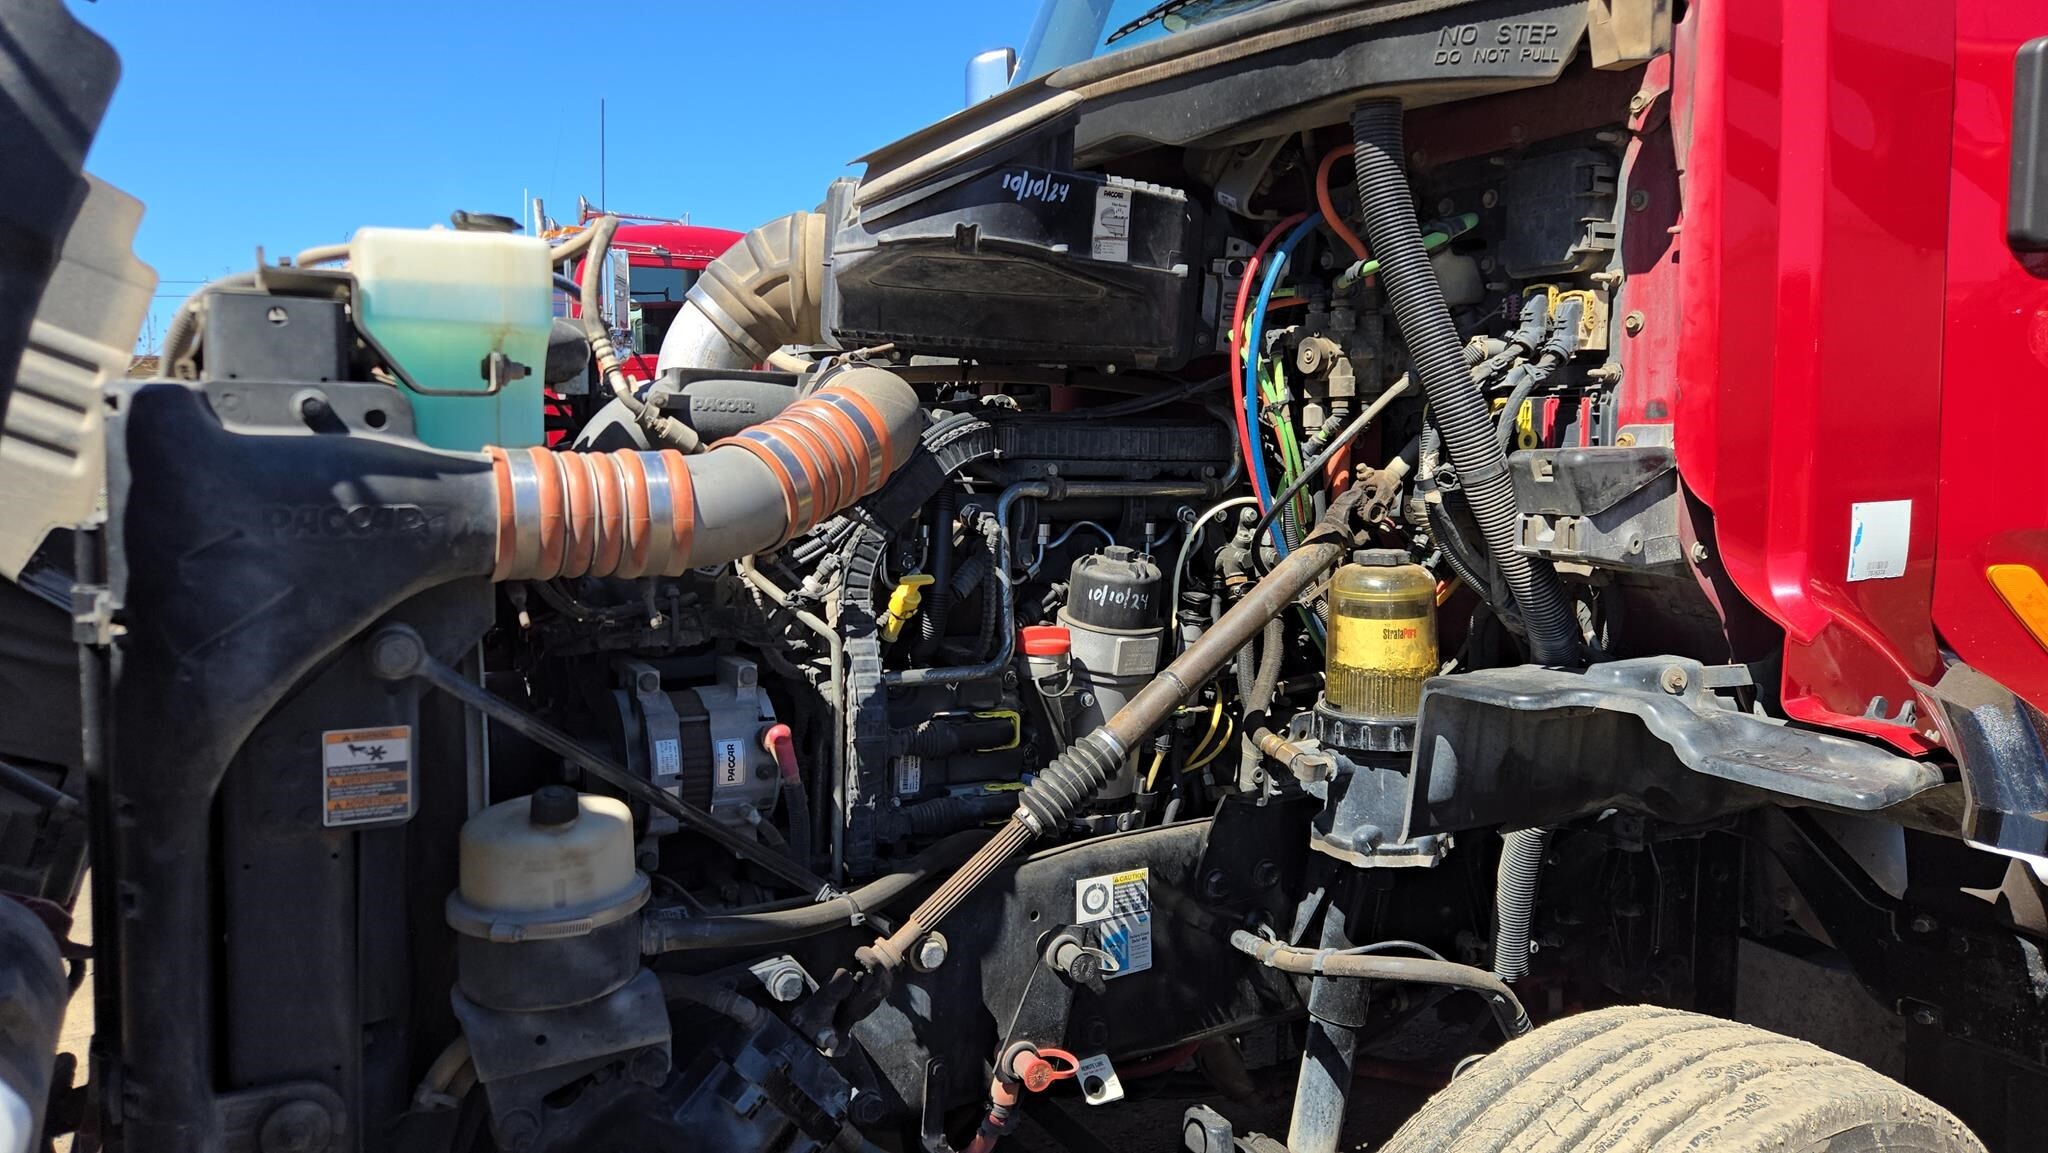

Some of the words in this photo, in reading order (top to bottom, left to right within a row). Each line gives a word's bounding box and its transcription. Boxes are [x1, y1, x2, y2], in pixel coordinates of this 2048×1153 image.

[1438, 25, 1478, 47] NO
[1496, 23, 1559, 45] STEP
[1434, 49, 1462, 65] DO
[1473, 48, 1510, 63] NOT
[1520, 47, 1560, 63] PULL
[1002, 170, 1070, 202] 10/10/24
[1103, 190, 1124, 199] PACCAR
[693, 398, 756, 414] PACCAR
[1088, 584, 1149, 610] 10/10/24
[727, 743, 736, 782] PACCAR
[1120, 871, 1146, 883] CAUTION
